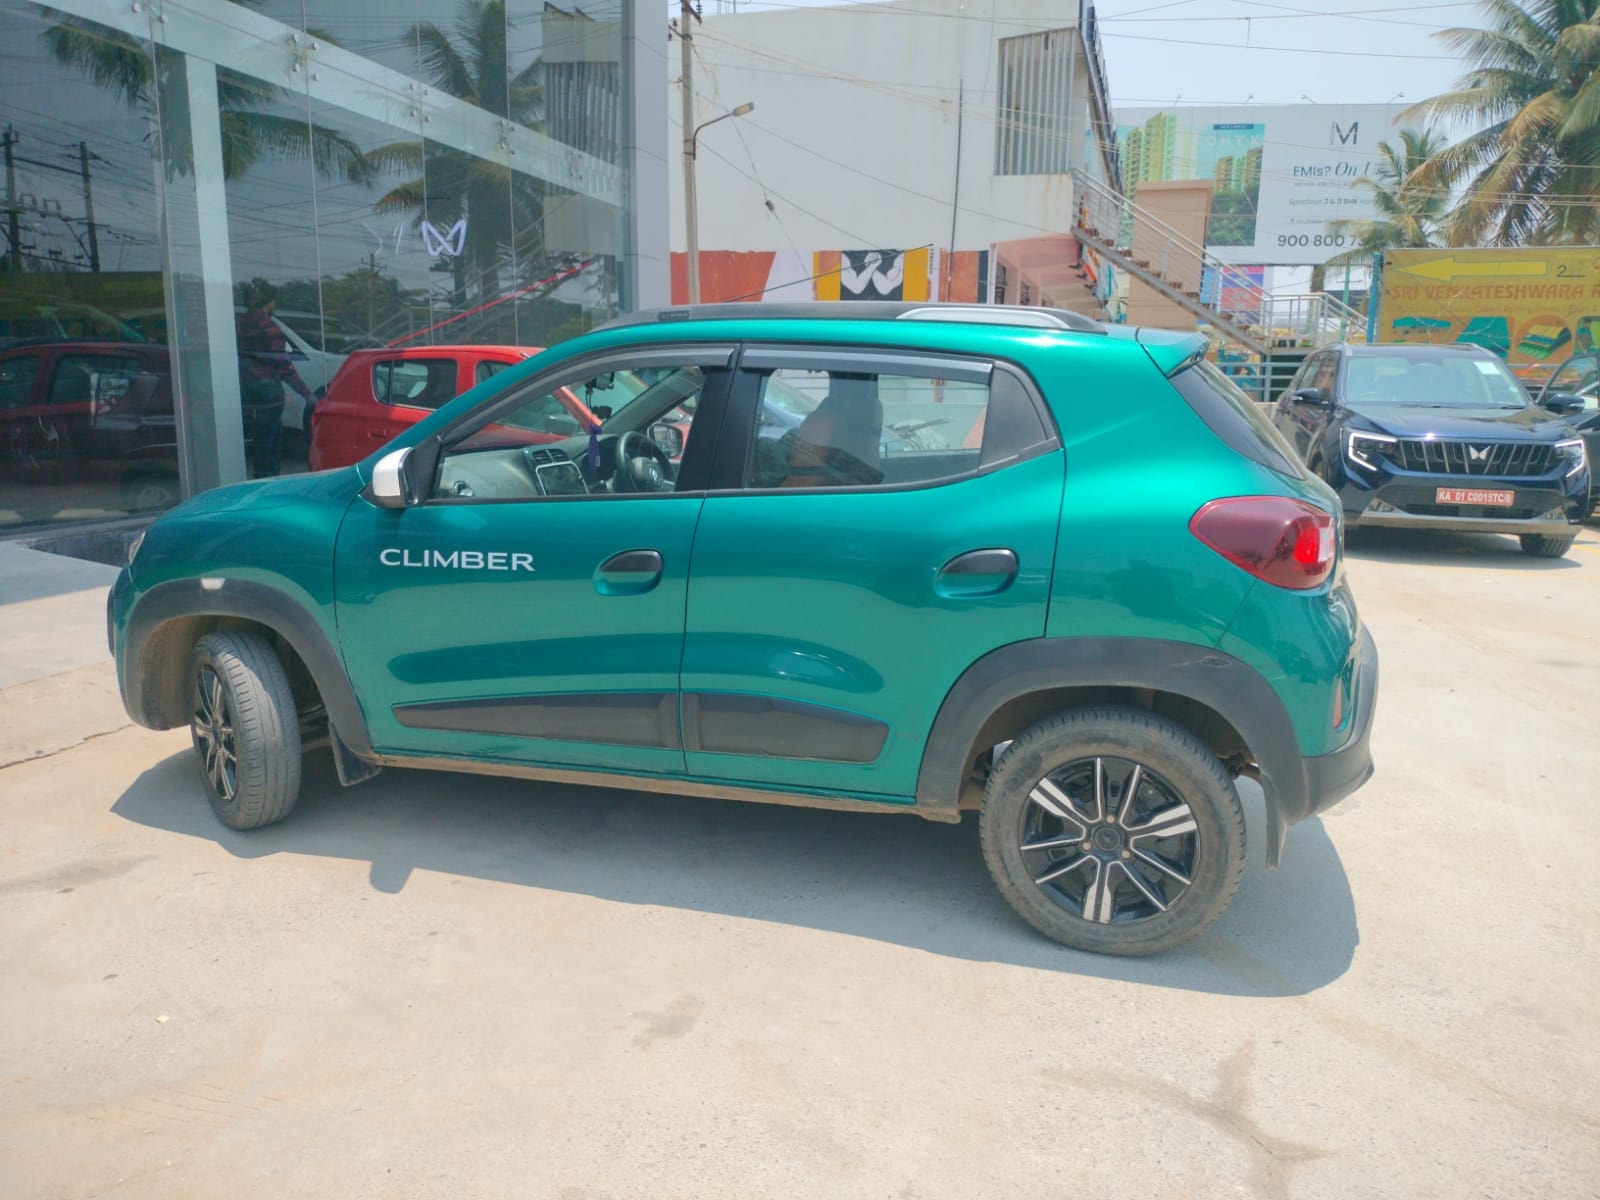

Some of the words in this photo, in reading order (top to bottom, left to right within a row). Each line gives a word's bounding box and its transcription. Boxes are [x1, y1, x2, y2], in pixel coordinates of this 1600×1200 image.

[1335, 161, 1358, 177] On
[1278, 234, 1309, 247] 900
[1313, 234, 1345, 247] 800
[1392, 285, 1418, 299] SRI
[1425, 284, 1584, 300] VENKATESHWARA
[1439, 490, 1451, 501] KA
[1455, 492, 1465, 502] 01
[379, 548, 536, 572] CLIMBER
